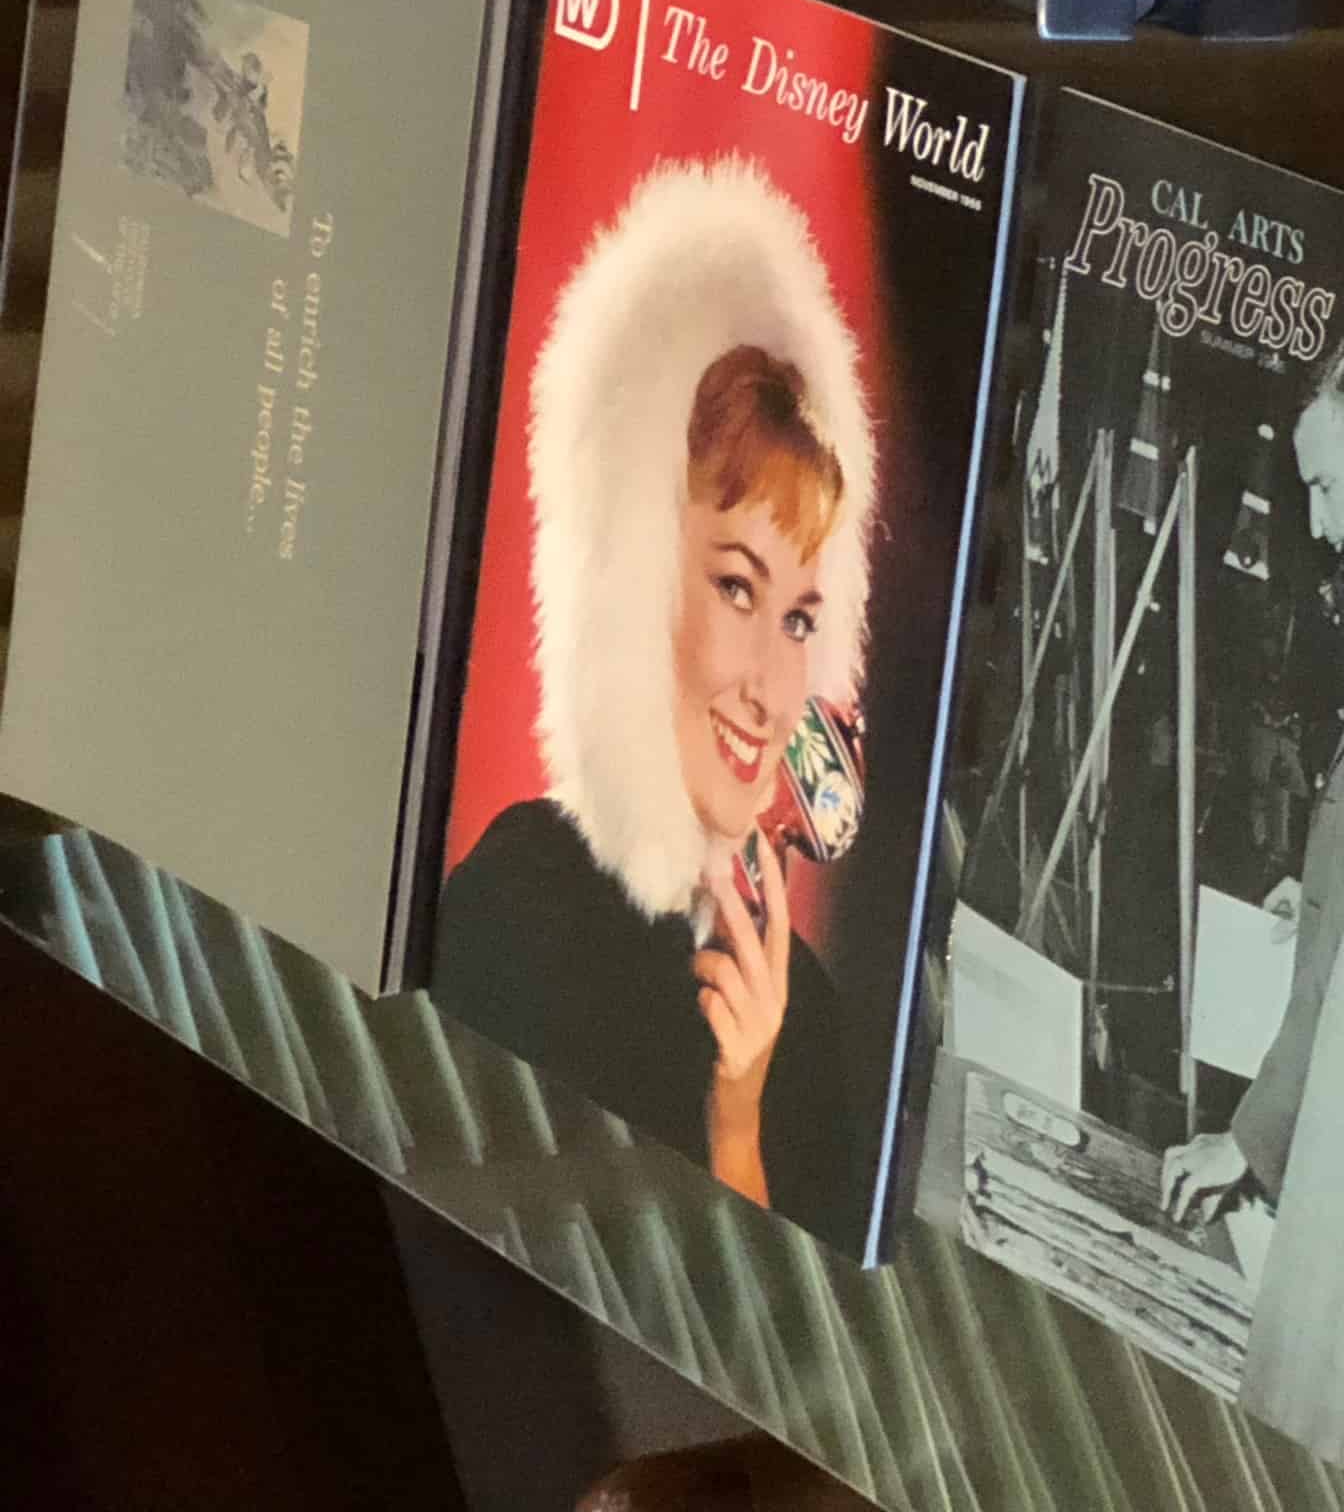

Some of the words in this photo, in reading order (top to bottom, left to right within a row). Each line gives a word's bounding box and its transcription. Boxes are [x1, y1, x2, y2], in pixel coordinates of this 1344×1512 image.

[660, 6, 730, 80] The
[741, 36, 870, 144] Disney
[883, 86, 990, 183] World
[310, 211, 333, 258] To
[1151, 179, 1209, 230] CAL
[1227, 208, 1306, 264] ARTS
[270, 278, 289, 320] of
[1064, 172, 1337, 361] Progress
[264, 327, 286, 376] all
[296, 271, 321, 390] enrich
[288, 405, 313, 466] the
[279, 478, 307, 561] lives
